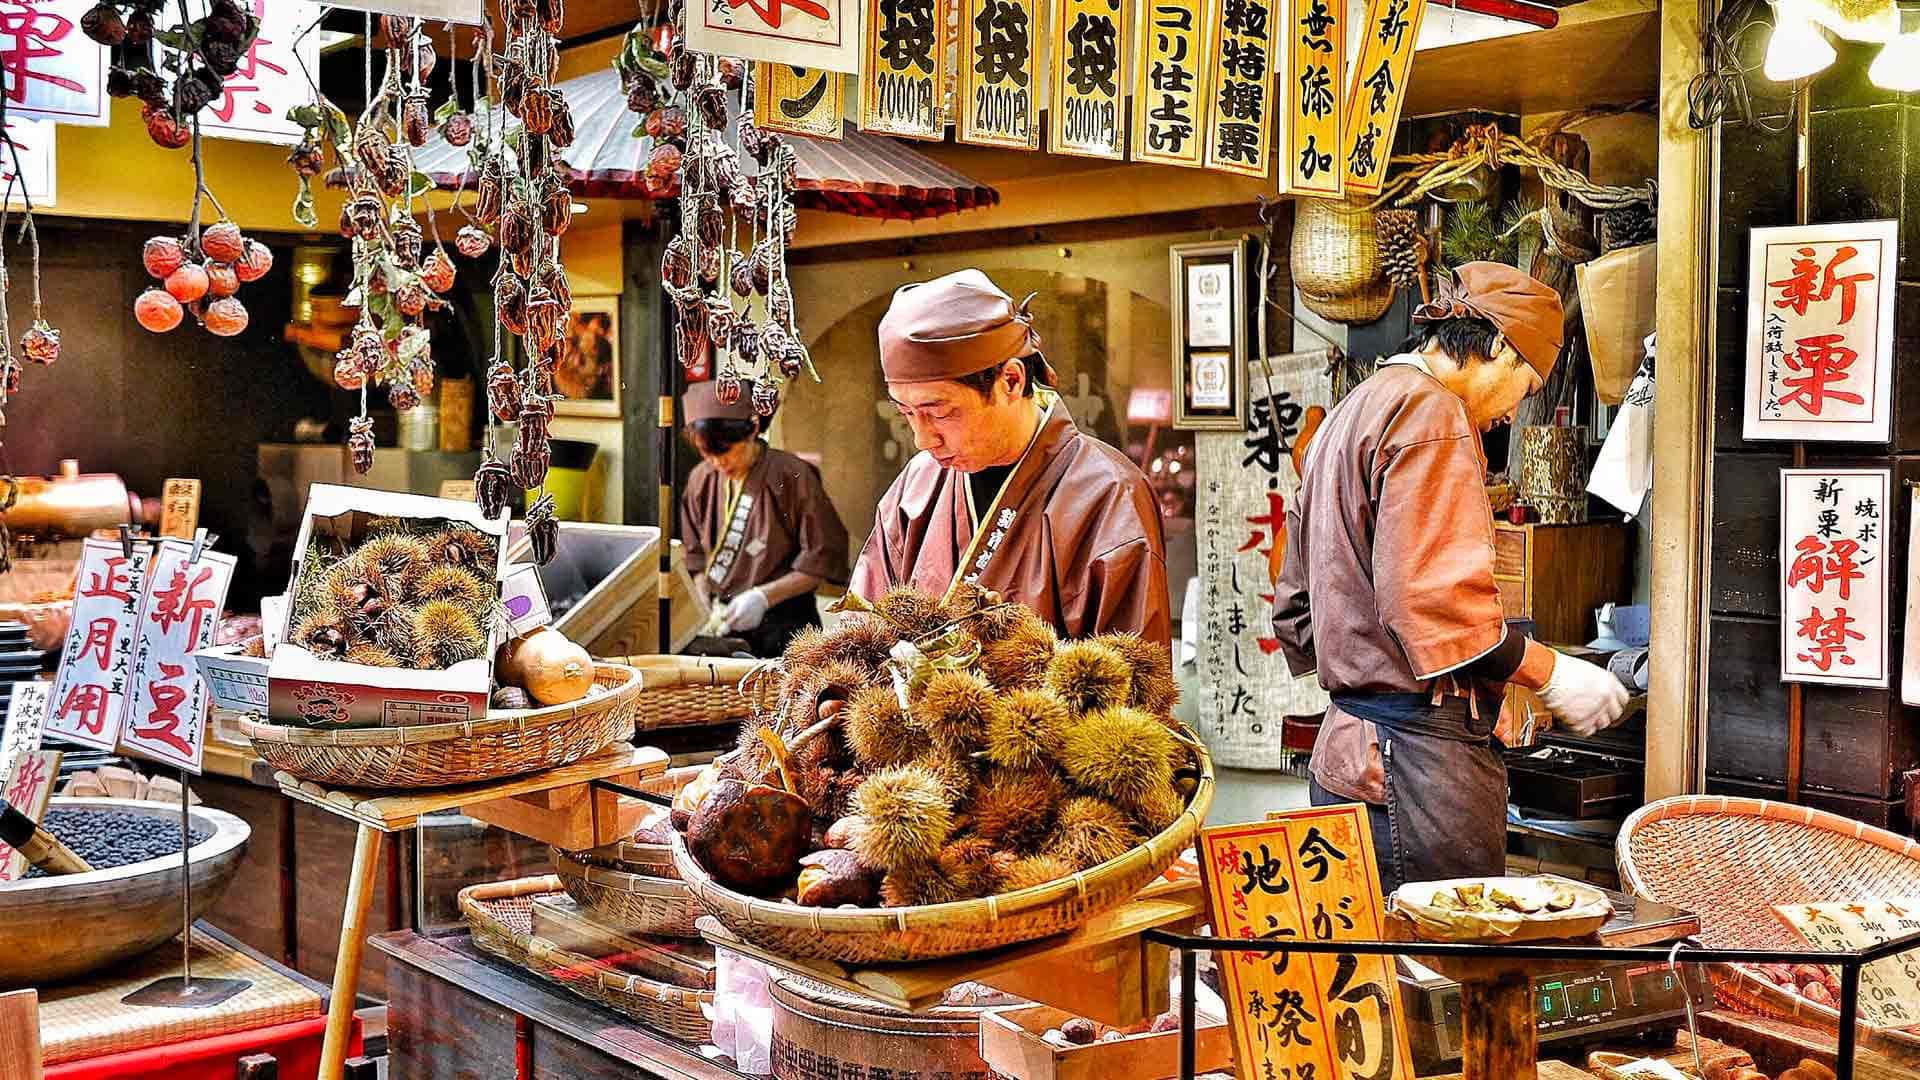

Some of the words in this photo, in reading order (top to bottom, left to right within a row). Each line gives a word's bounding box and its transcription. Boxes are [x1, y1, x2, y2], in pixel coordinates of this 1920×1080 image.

[975, 0, 1029, 87] 袋
[1067, 0, 1118, 97] 袋
[1299, 0, 1336, 180] 無添加
[1347, 0, 1410, 178] 新食感
[976, 85, 1029, 137] 2000円
[1065, 96, 1115, 148] 3000円
[1764, 312, 1787, 418] 入荷致しました。
[1768, 246, 1876, 416] 新栗
[1813, 478, 1845, 539] 新栗
[1854, 498, 1881, 566] 焼ポン
[60, 556, 131, 735] 正月用
[133, 566, 216, 758] 新豆
[1226, 561, 1263, 735] しました。
[1787, 535, 1867, 672] 解禁
